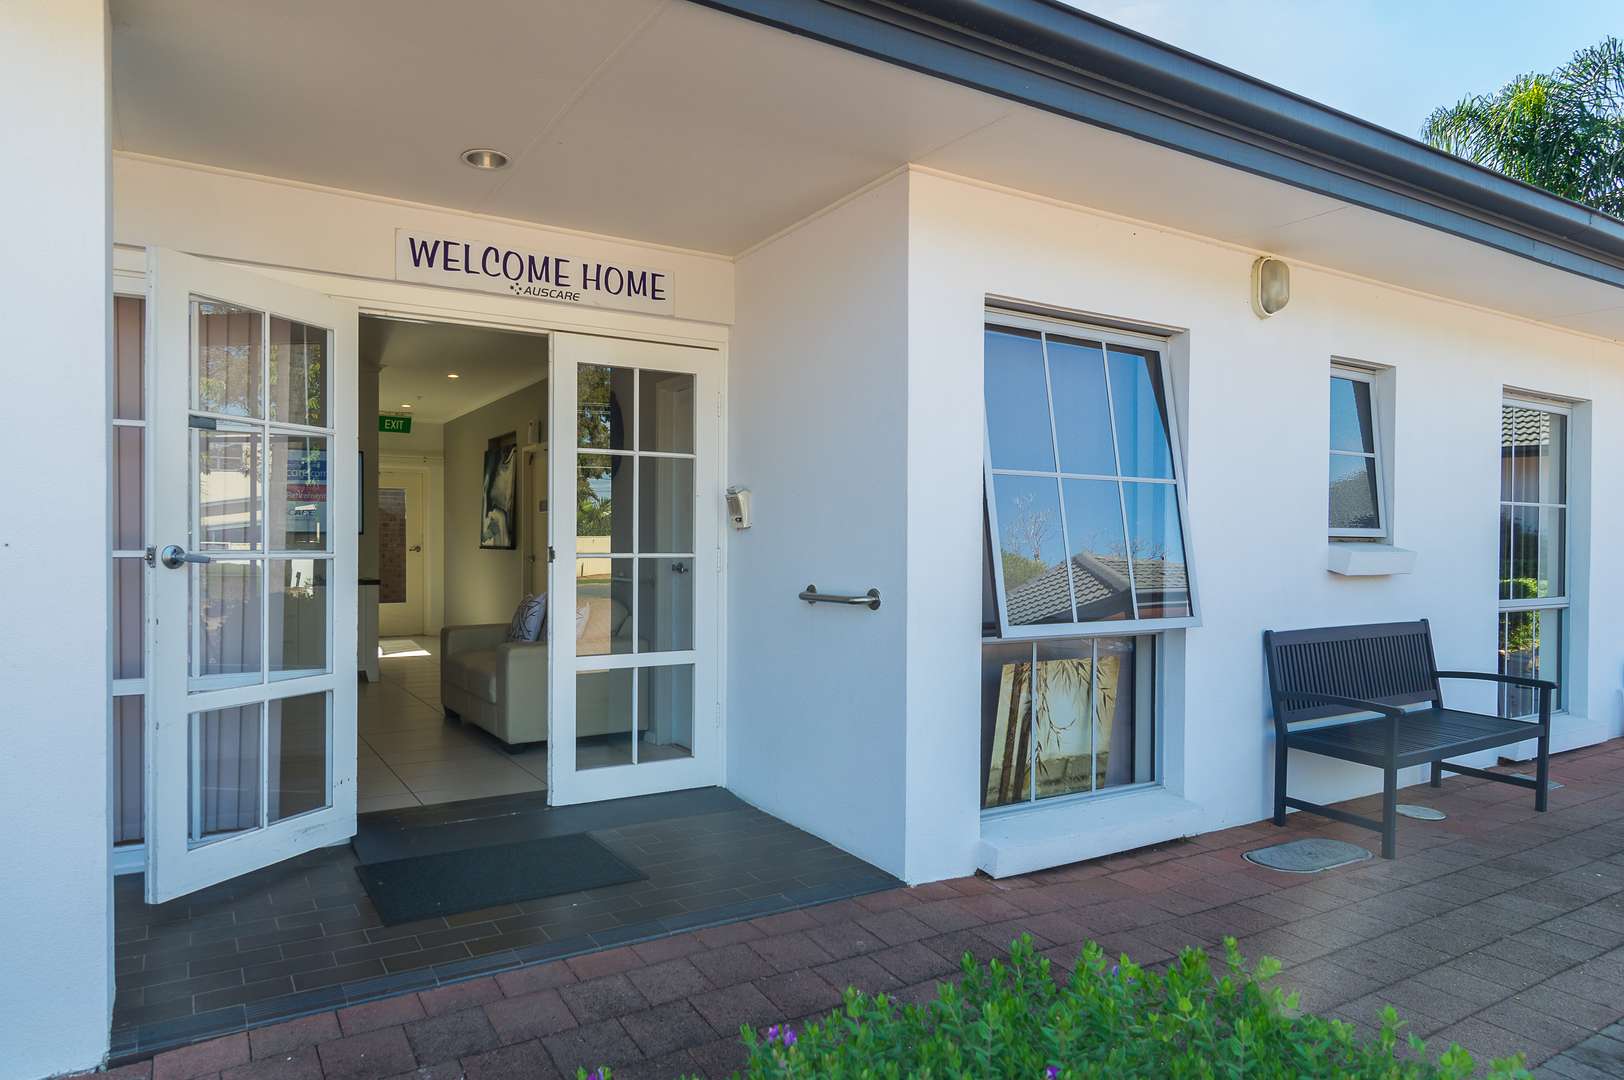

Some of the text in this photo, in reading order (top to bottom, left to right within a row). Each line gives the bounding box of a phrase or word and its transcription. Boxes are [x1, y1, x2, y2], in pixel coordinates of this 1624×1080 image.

[408, 236, 667, 301] WELCOME HOME
[523, 286, 581, 302] AUSCARE
[383, 418, 405, 431] EXIT
